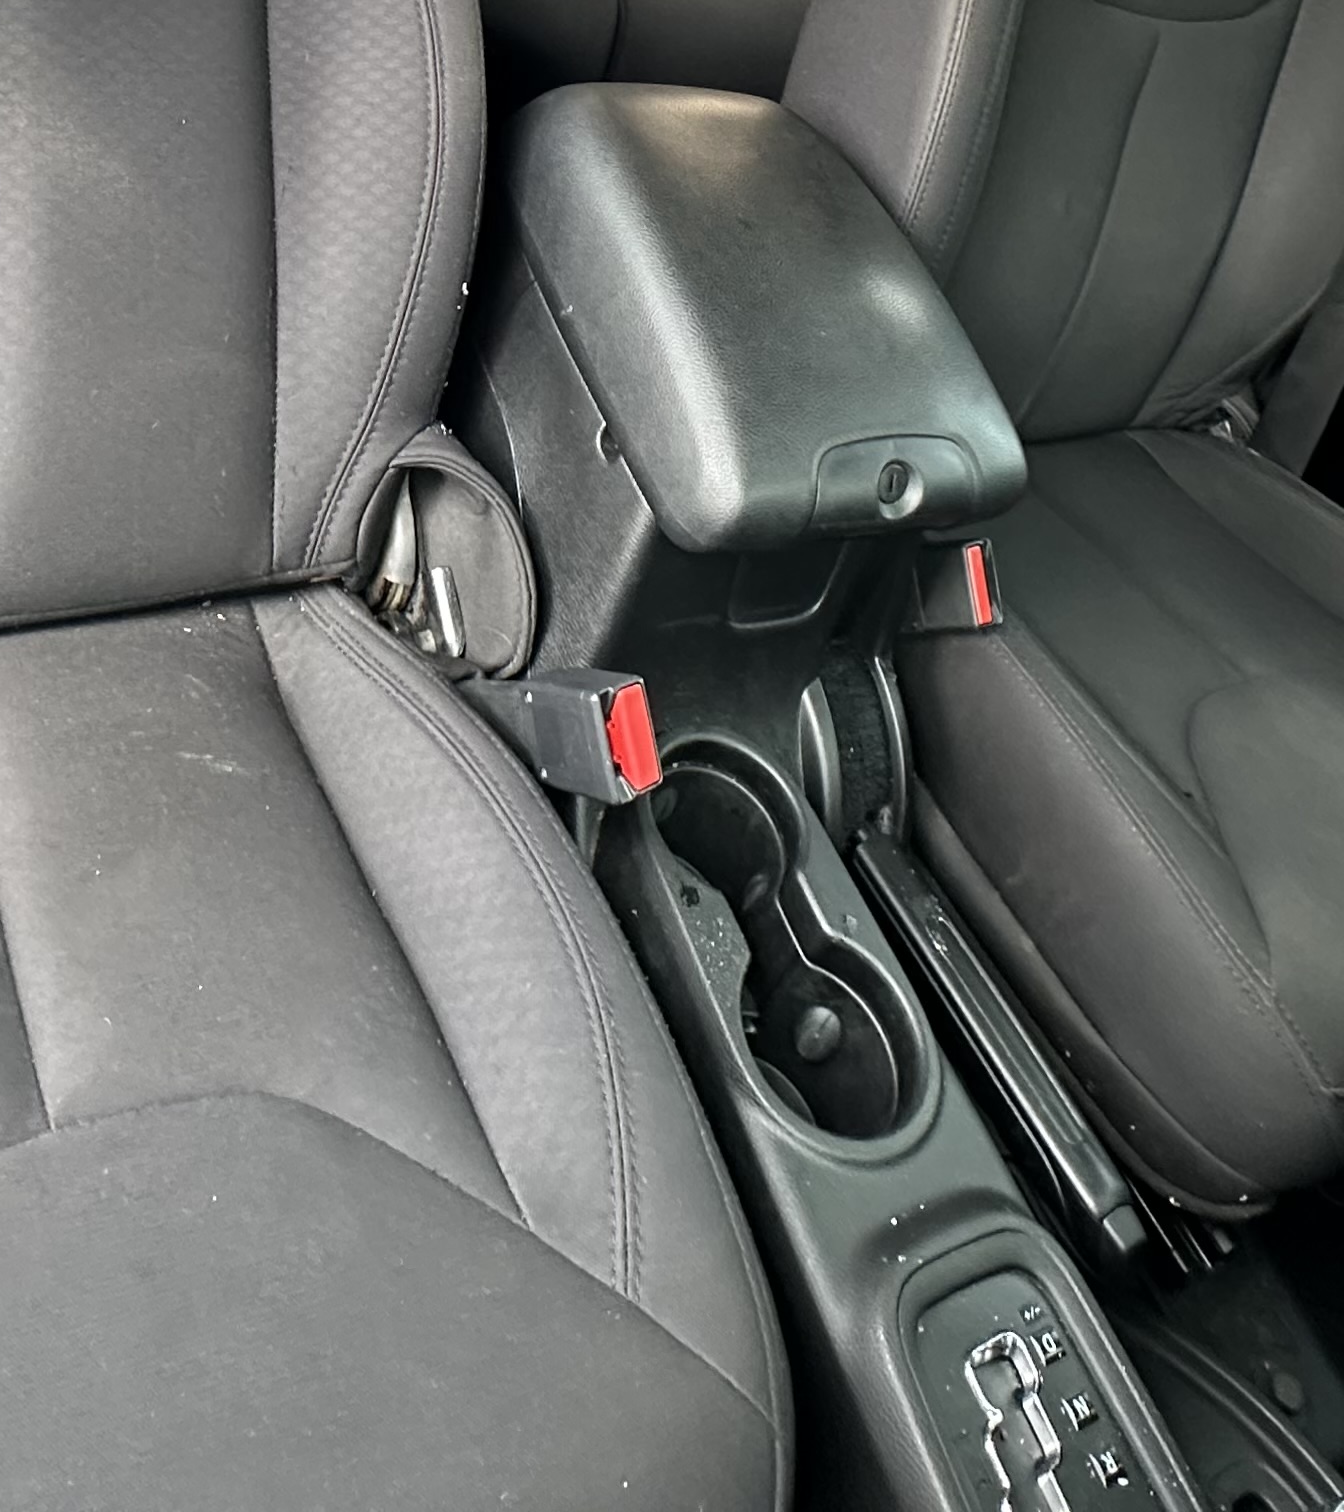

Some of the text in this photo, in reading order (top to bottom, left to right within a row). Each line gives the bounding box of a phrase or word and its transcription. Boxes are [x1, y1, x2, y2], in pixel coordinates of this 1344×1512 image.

[1042, 1332, 1057, 1353] D
[1072, 1395, 1091, 1420] N
[1100, 1451, 1119, 1474] R
